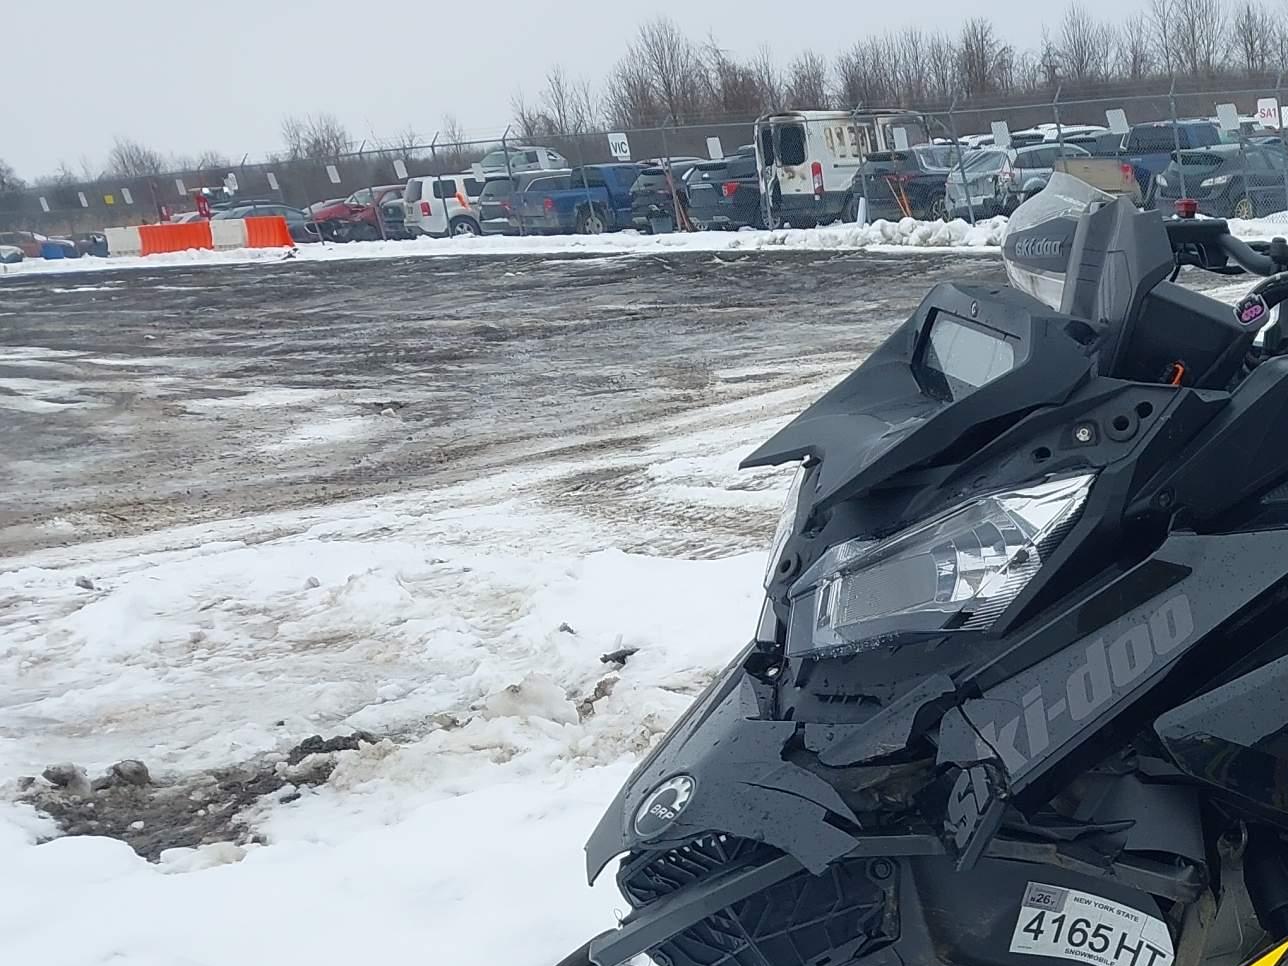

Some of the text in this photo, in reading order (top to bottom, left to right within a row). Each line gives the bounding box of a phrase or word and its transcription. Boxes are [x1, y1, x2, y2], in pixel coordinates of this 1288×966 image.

[1260, 107, 1277, 118] SA1
[611, 141, 628, 154] VIC
[650, 804, 675, 820] BRP
[1036, 893, 1051, 904] 26
[1074, 897, 1139, 922] NEW YORK STATE
[1064, 948, 1115, 966] SNOWMOBILE
